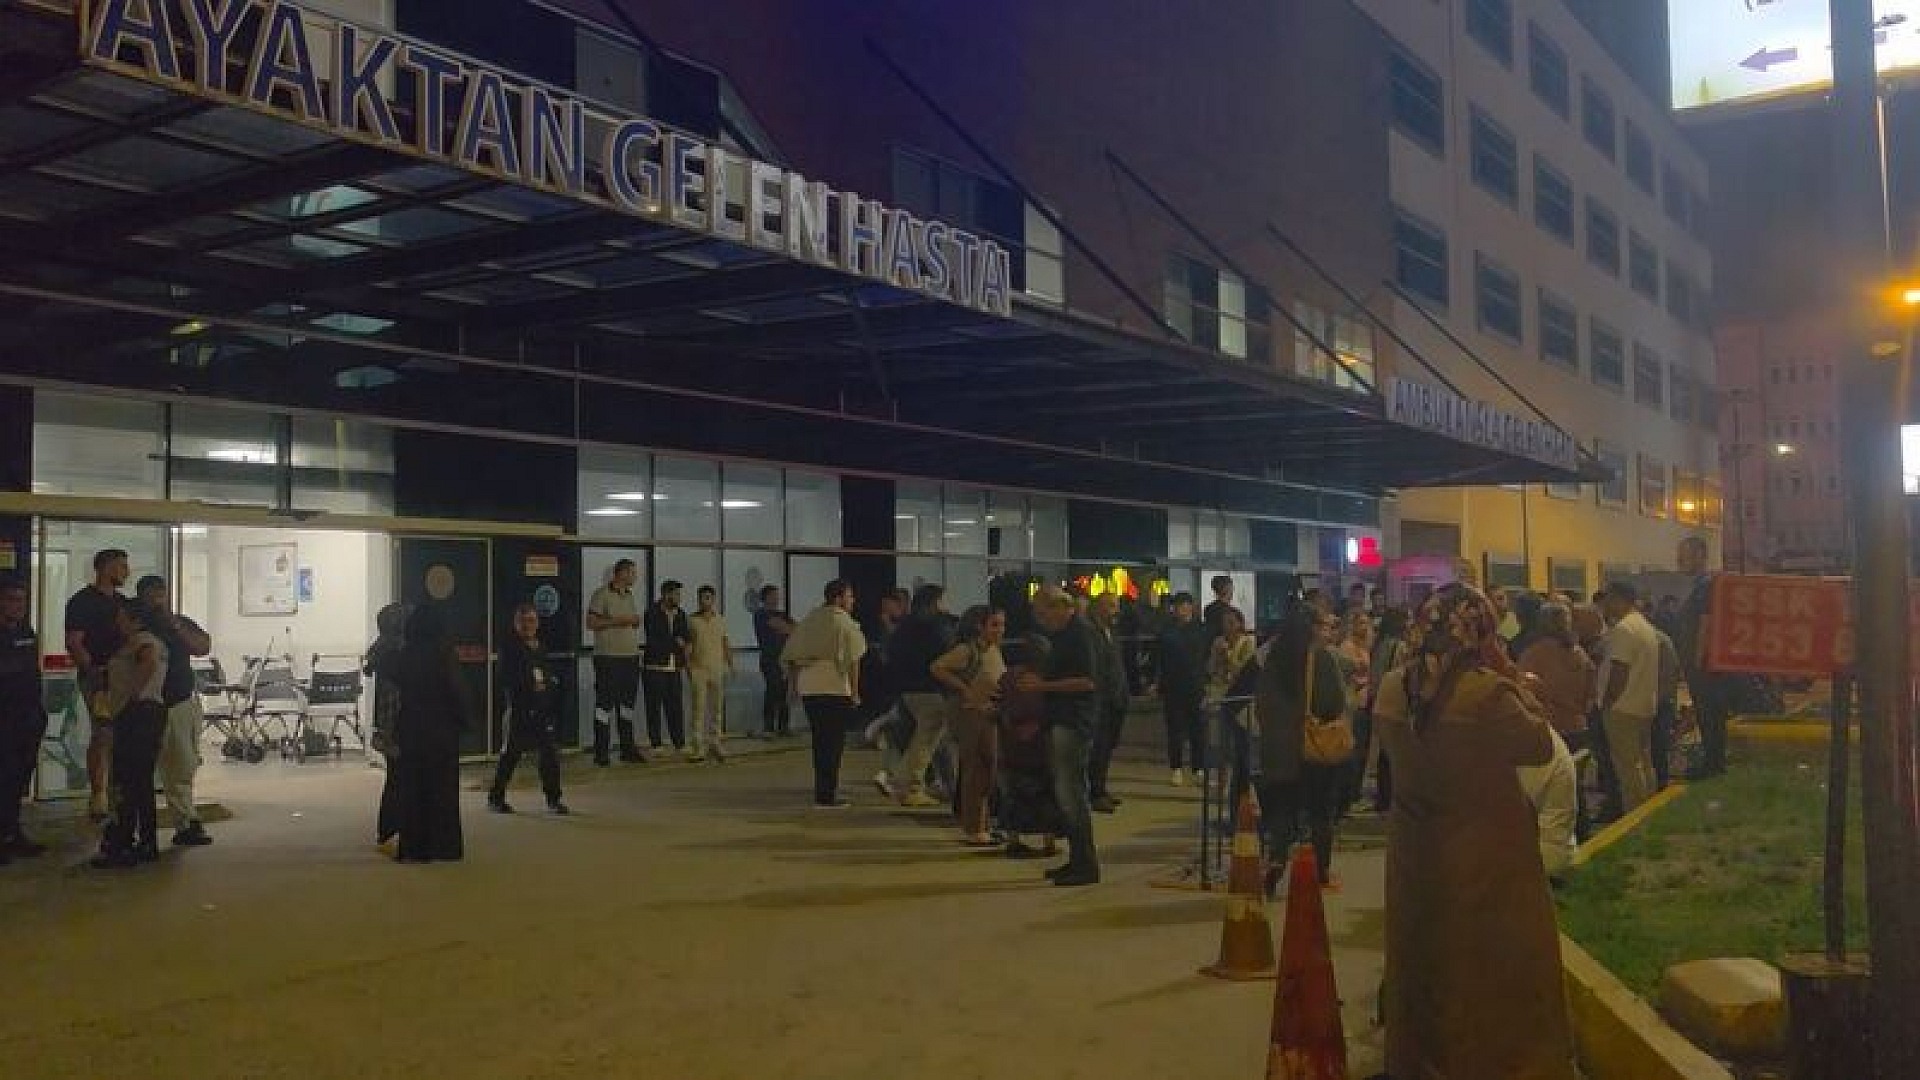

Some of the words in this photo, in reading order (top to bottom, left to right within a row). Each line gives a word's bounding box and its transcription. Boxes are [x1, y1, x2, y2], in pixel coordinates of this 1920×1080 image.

[90, 0, 584, 195] AYAKTAN
[608, 120, 830, 262] GELEN
[840, 192, 1010, 317] HASTA
[1728, 619, 1813, 659] 253
